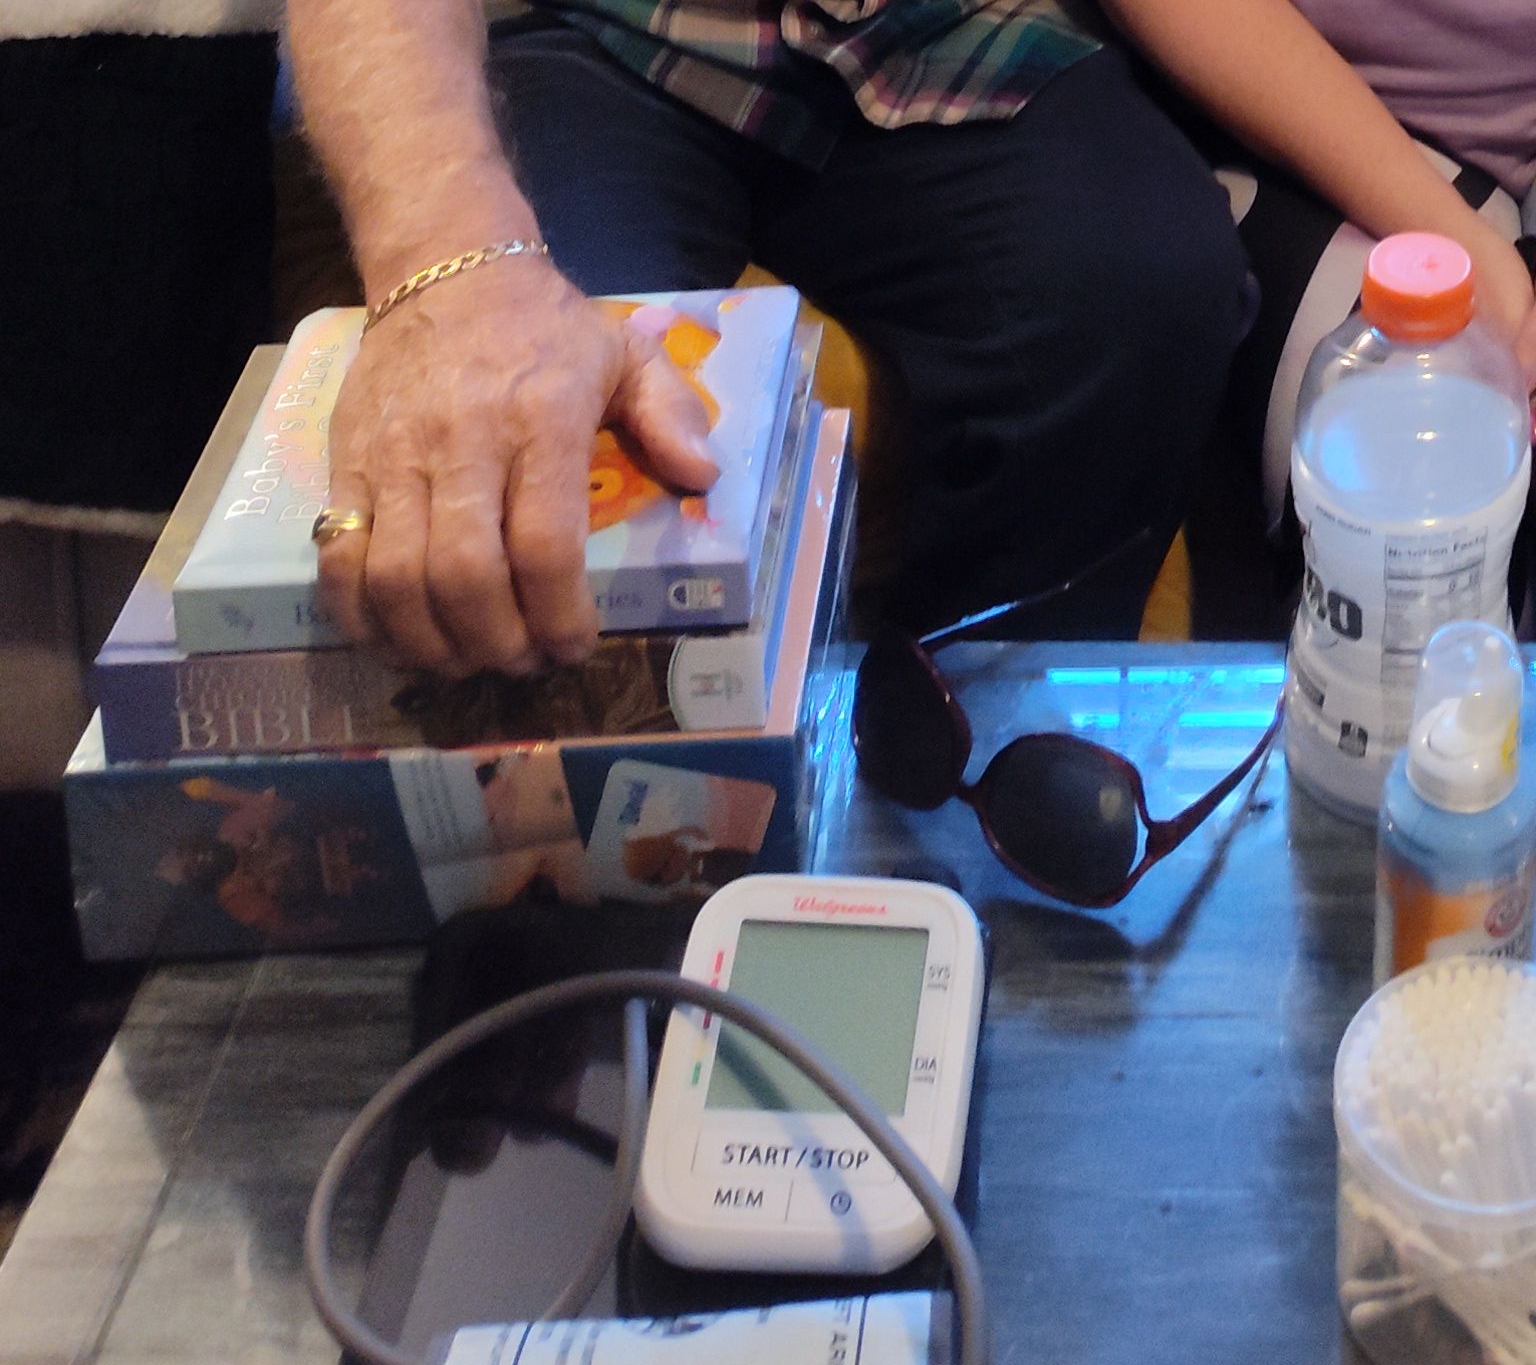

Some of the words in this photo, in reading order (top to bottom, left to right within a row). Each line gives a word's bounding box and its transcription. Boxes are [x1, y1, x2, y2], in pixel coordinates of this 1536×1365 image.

[224, 418, 305, 521] Baby's
[273, 342, 341, 412] First
[792, 896, 888, 917] Walgreens
[928, 965, 951, 981] SYS
[913, 1056, 938, 1072] DIA
[712, 1187, 764, 1209] MEM
